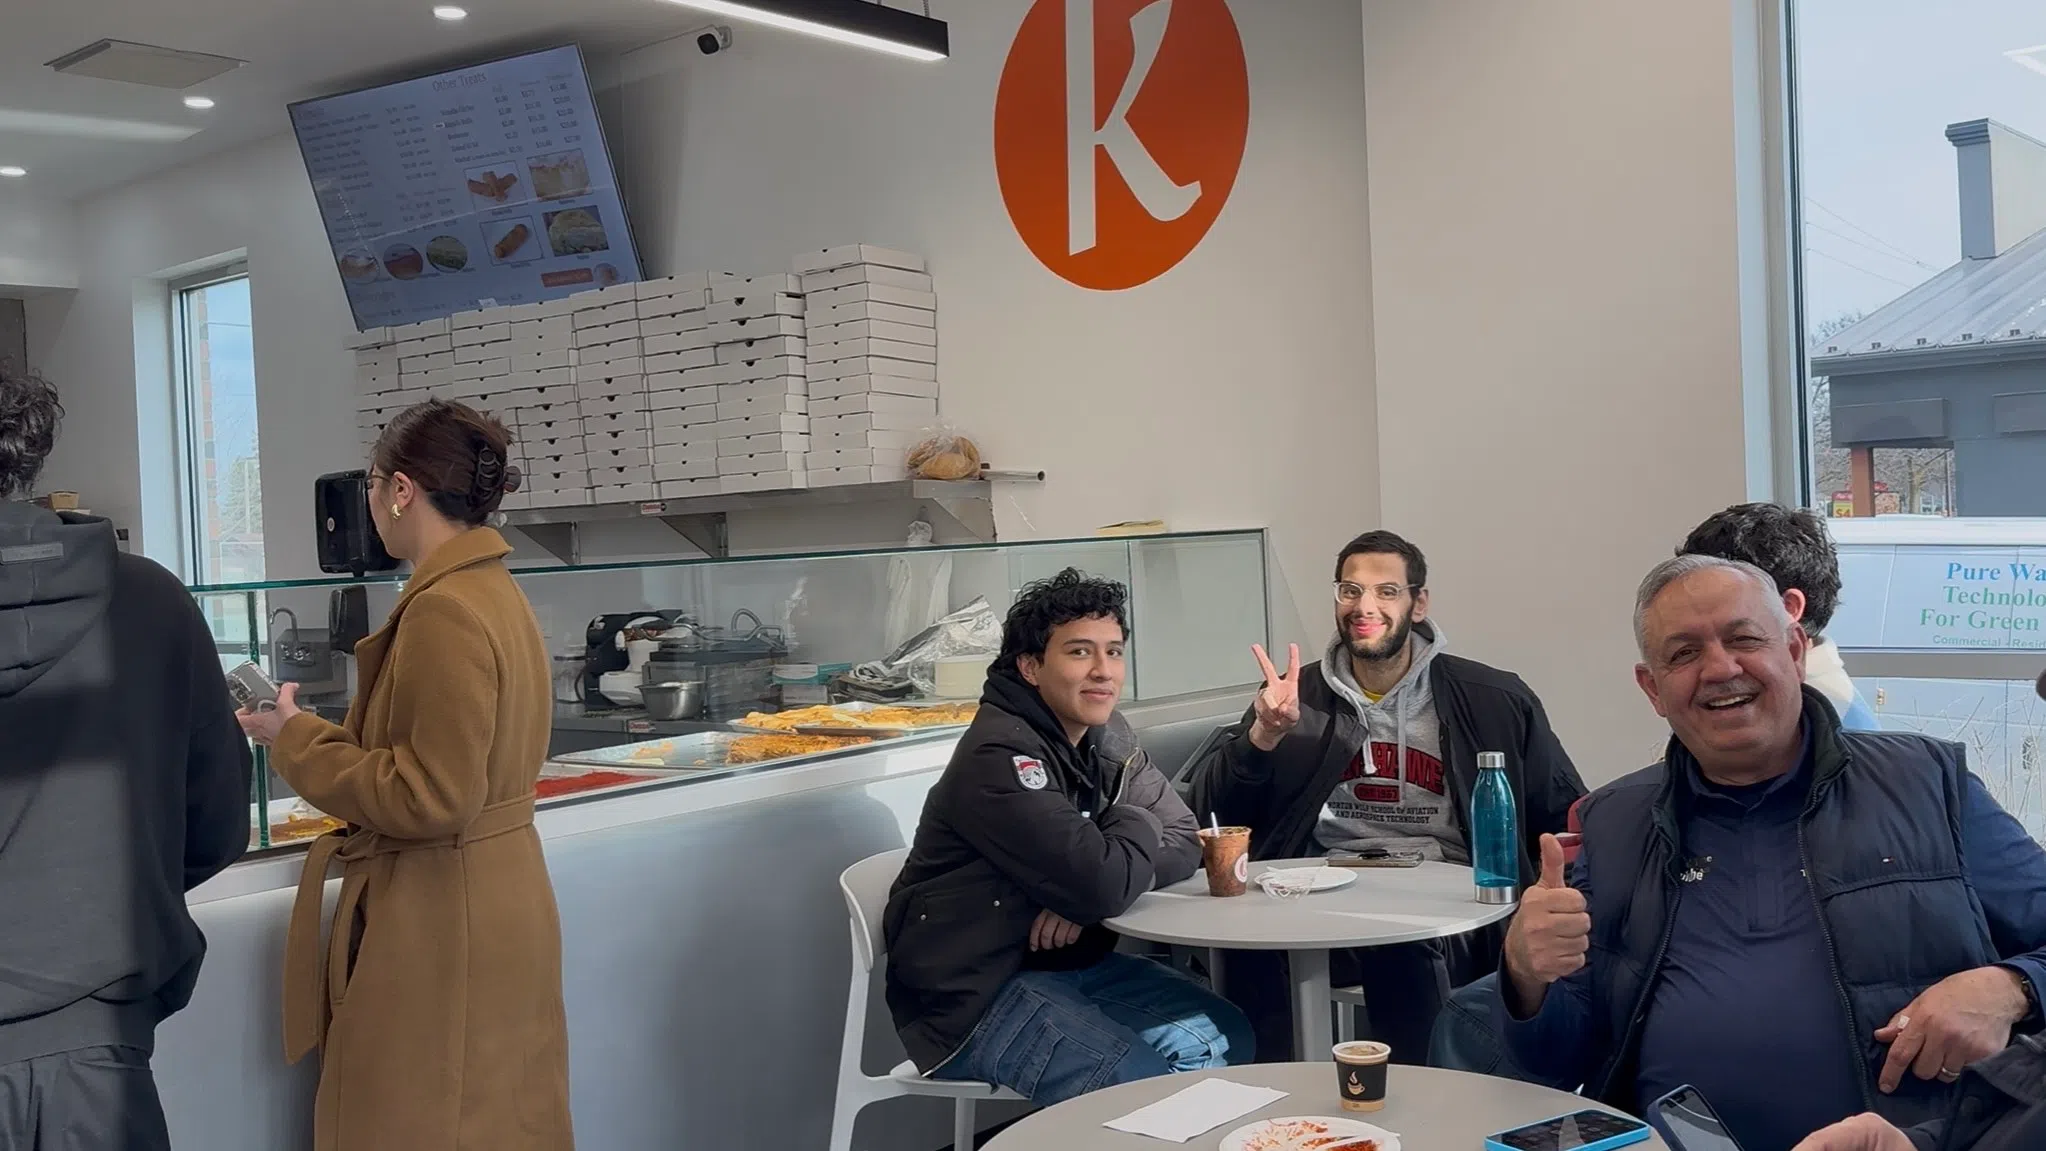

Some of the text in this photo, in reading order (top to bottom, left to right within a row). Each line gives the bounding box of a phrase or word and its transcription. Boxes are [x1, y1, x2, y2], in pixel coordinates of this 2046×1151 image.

[1065, 0, 1202, 256] K
[1947, 562, 2046, 581] Pure Wa
[1943, 585, 2046, 607] Technolo
[1920, 608, 2040, 631] For Green
[1933, 635, 2002, 647] Commercial
[1335, 810, 1430, 824] AND AEROSPACE TECHNOLOGY
[1371, 805, 1394, 814] SCHOOL
[1396, 806, 1405, 814] OF
[1406, 806, 1439, 815] AVIATION
